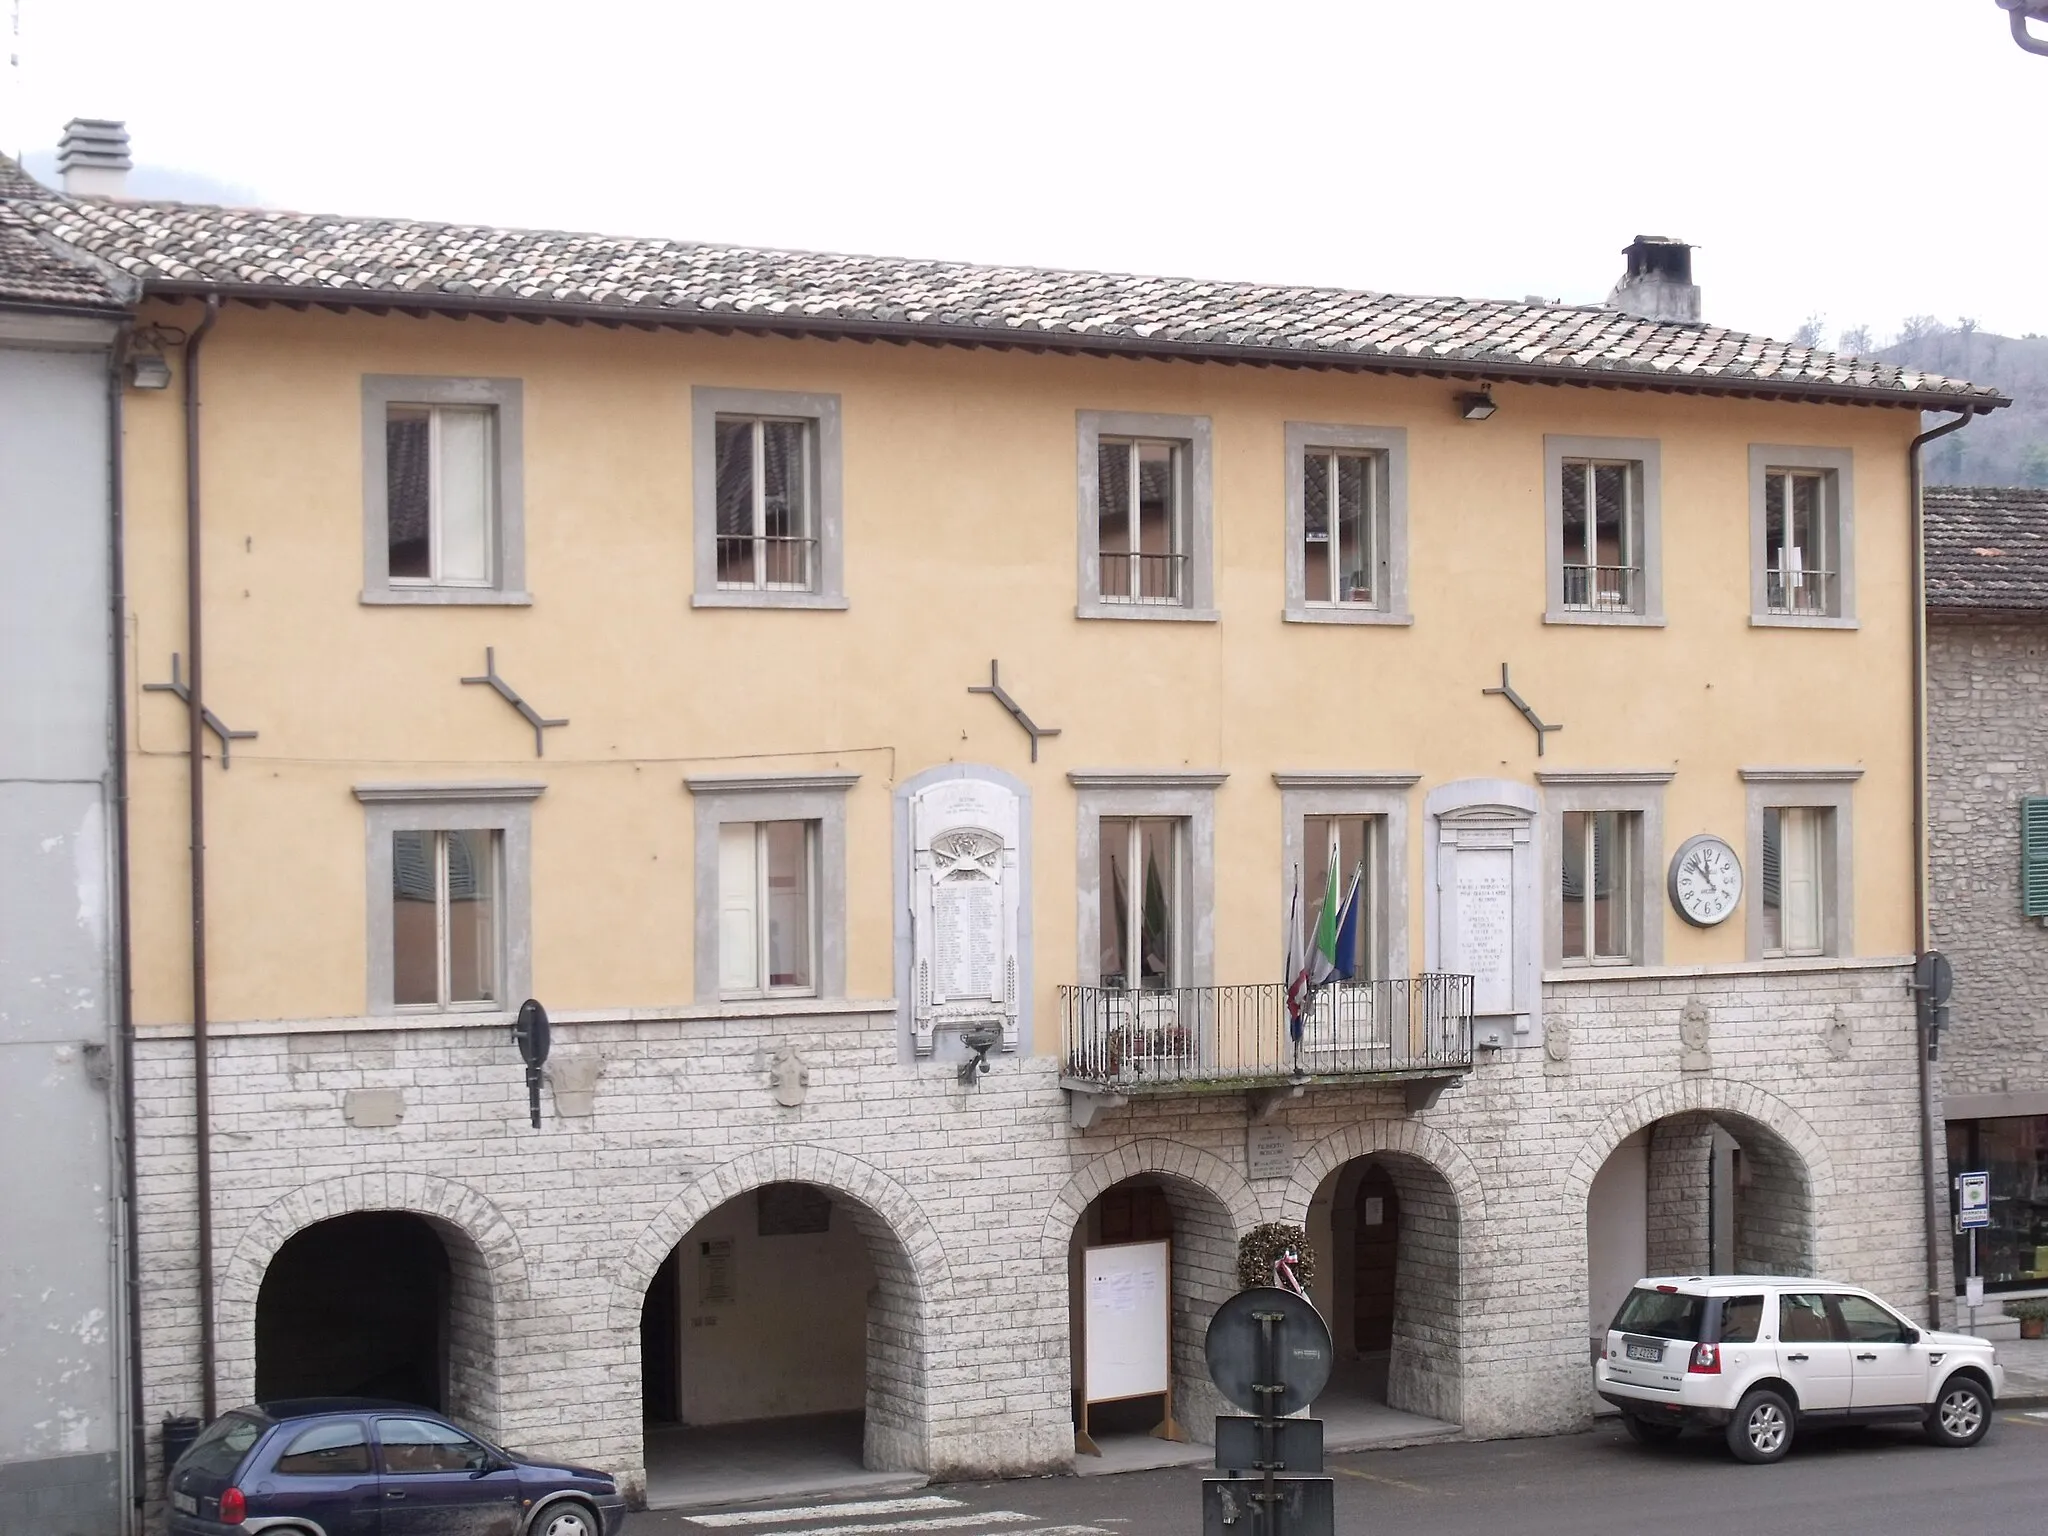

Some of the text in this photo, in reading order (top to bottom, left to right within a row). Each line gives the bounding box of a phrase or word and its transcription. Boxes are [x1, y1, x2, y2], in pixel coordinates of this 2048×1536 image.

[1703, 849, 1712, 862] 12
[1715, 853, 1721, 864] 1
[1720, 863, 1730, 874] 2
[1682, 878, 1692, 886] 9
[1684, 890, 1695, 900] 8
[1693, 898, 1702, 910] 7
[1704, 901, 1711, 914] 6
[1715, 898, 1722, 911] 5
